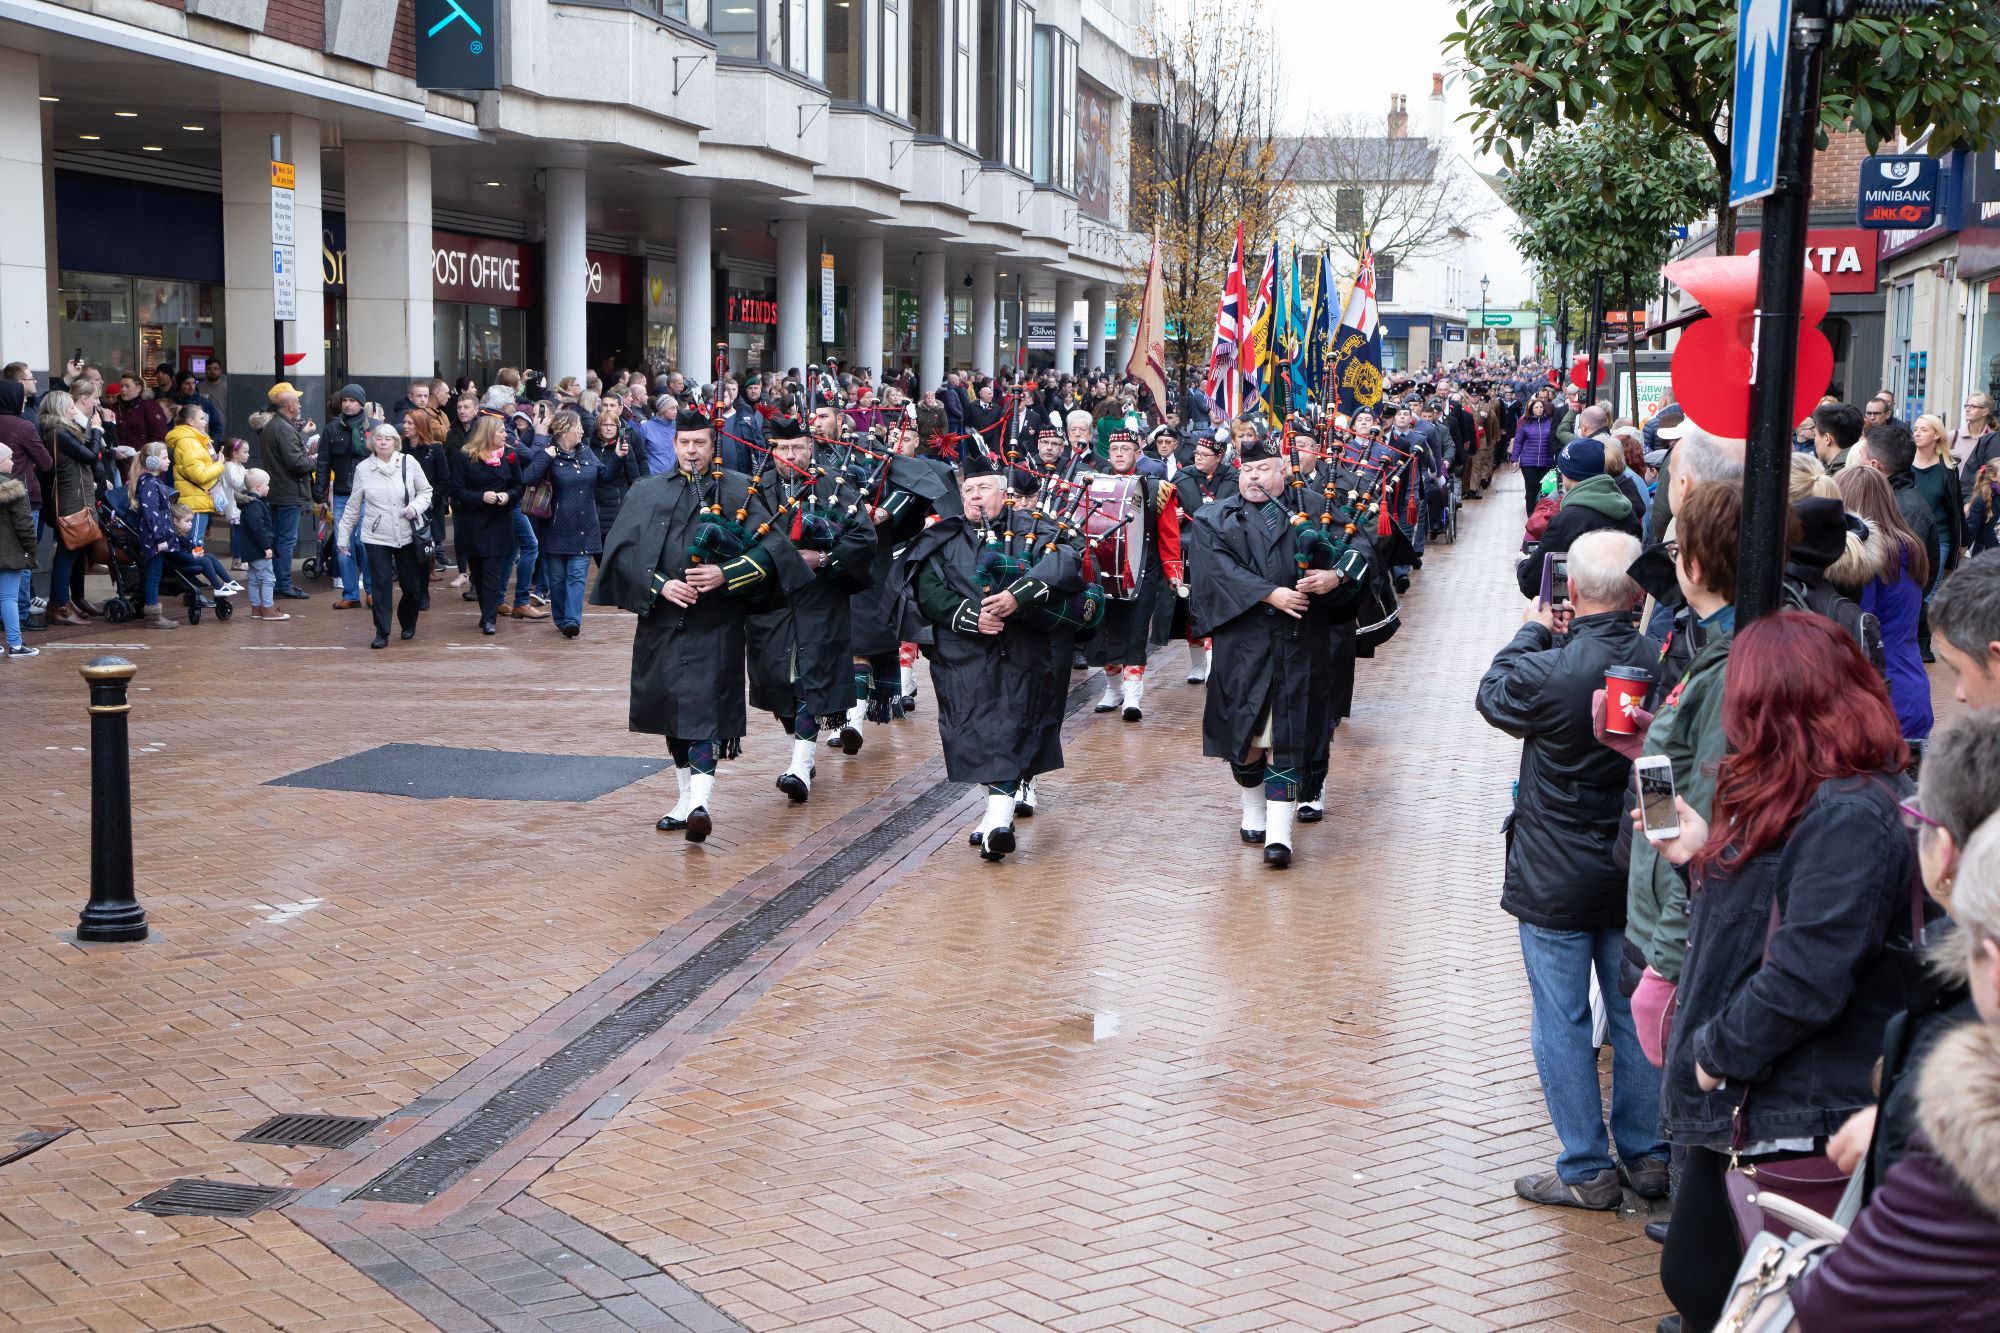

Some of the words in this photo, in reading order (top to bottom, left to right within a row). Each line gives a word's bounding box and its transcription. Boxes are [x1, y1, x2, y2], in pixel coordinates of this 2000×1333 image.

[1865, 190, 1931, 202] MINIBANK
[470, 253, 521, 292] OFFICE
[742, 298, 778, 325] HINDS
[1636, 393, 1661, 402] SAVE
